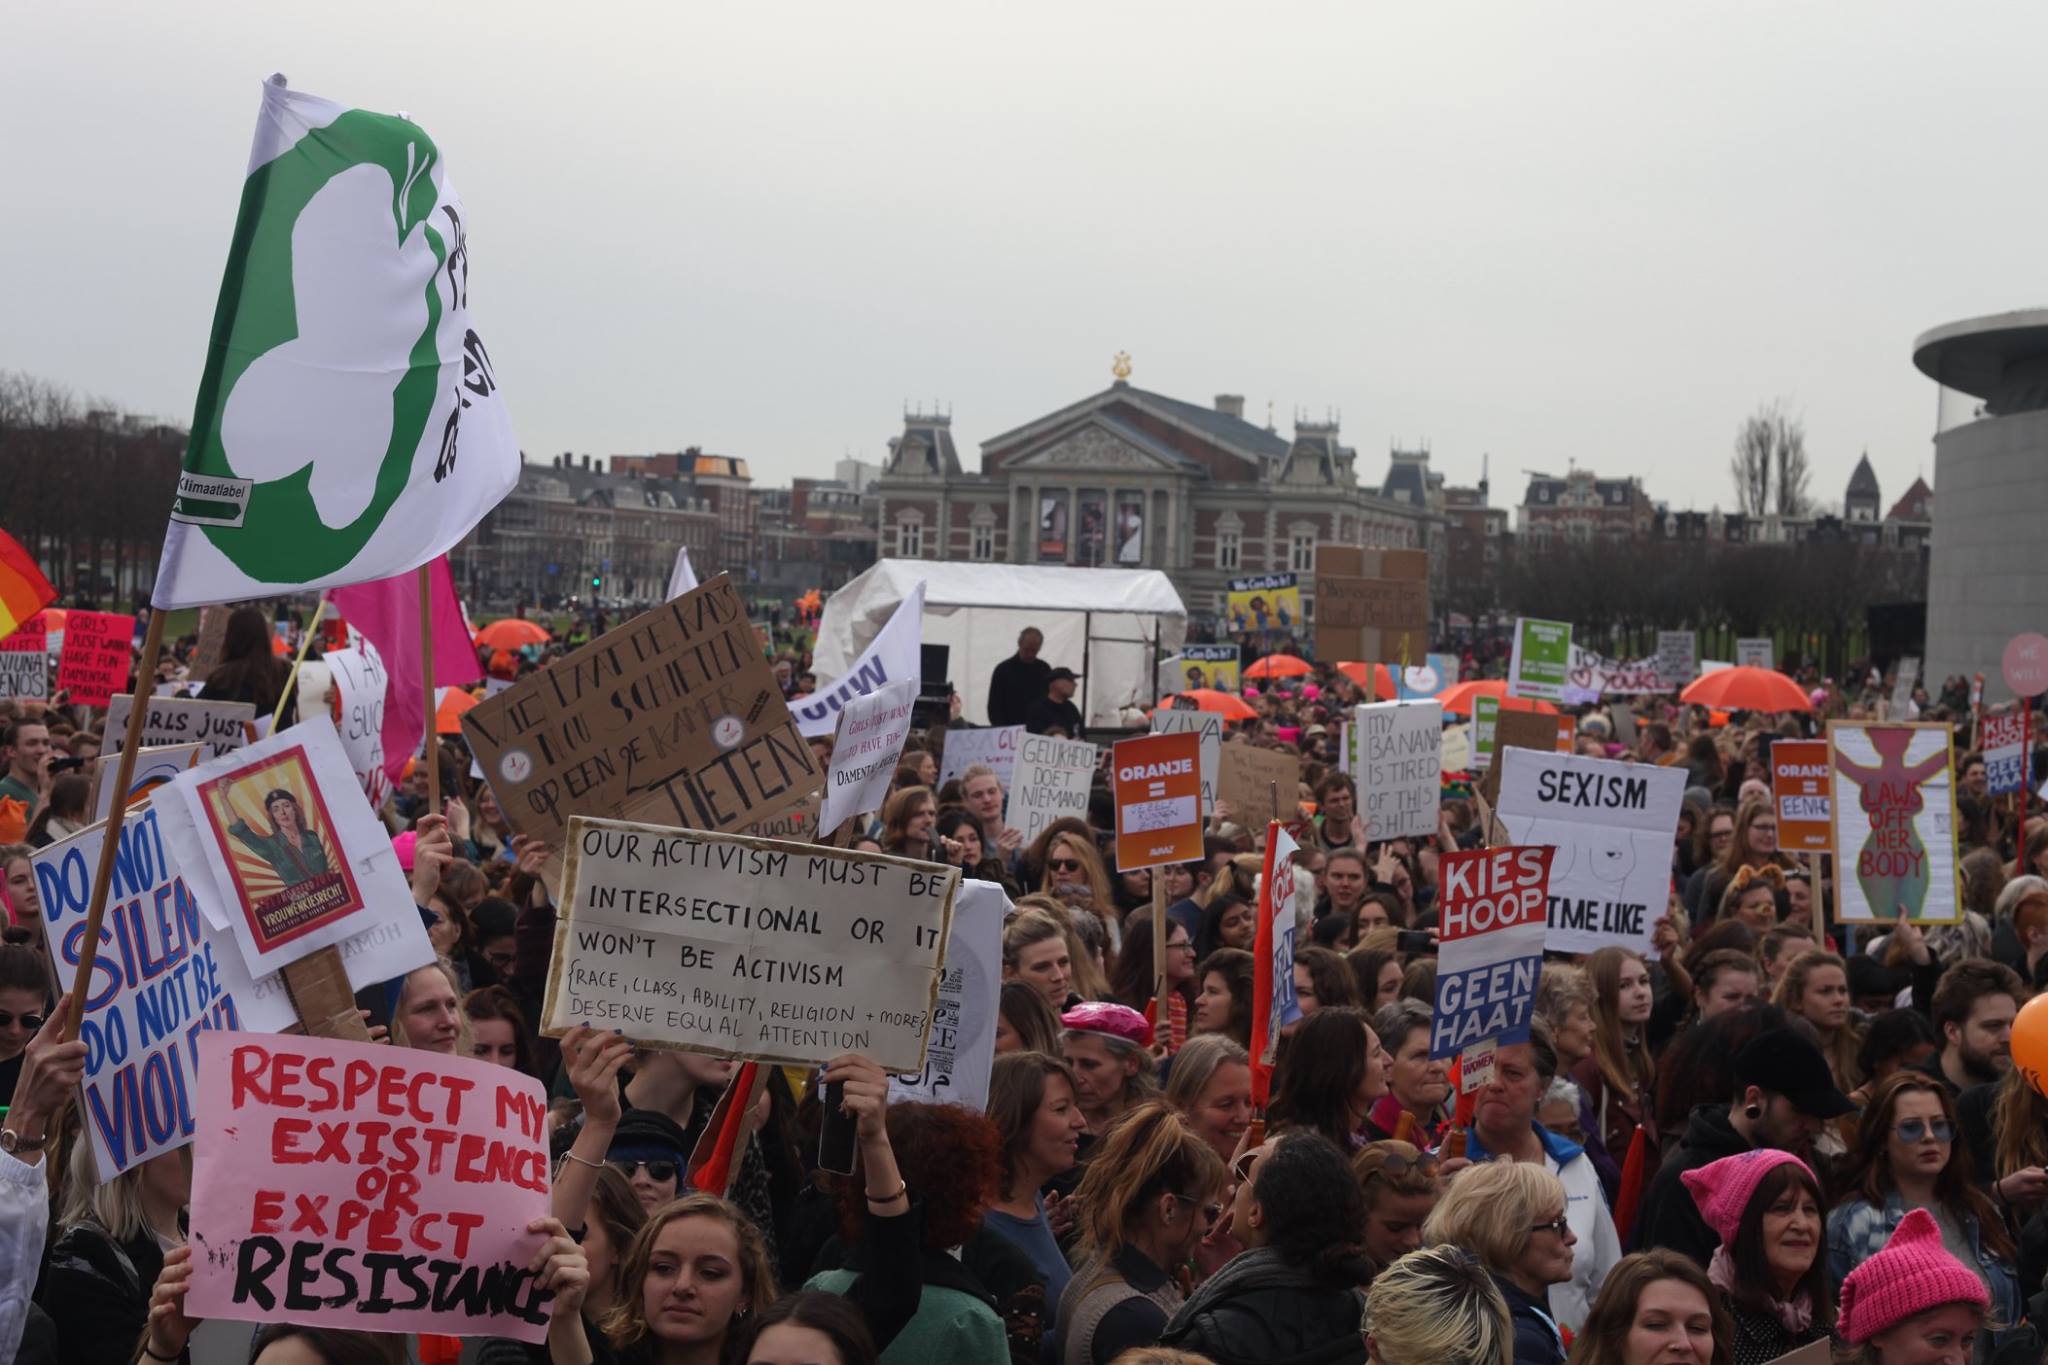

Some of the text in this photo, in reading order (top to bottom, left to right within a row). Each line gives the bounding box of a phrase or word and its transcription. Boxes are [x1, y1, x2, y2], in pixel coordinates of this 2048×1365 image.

[1234, 581, 1248, 591] We
[1248, 579, 1266, 589] Can
[1266, 577, 1279, 588] Do
[69, 614, 109, 633] GIRLS
[1187, 649, 1204, 660] Can
[1204, 649, 1217, 659] Do
[860, 736, 881, 753] HAVE
[1034, 766, 1074, 787] DOET
[1120, 758, 1193, 781] ORANJE
[1368, 756, 1439, 786] IS TIRED
[1537, 769, 1648, 809] SEXISM
[1021, 785, 1087, 810] NIEMAND
[1368, 786, 1433, 812] OF THIS
[1868, 808, 1912, 830] OFF
[1876, 829, 1909, 850] HER
[35, 808, 168, 923] DO NOT
[583, 829, 946, 898] OUR ACTIVISM MUST BE
[1444, 848, 1545, 900] KIES
[1860, 850, 1924, 878] BODY
[589, 885, 940, 951] INTERSECTIONAL OR IT
[1443, 888, 1545, 938] HOOP
[1602, 902, 1648, 935] LIKE
[578, 931, 843, 988] WON'T BE ACTIVISM
[1439, 956, 1535, 1016] GEEN
[81, 1004, 129, 1078] DO
[135, 962, 193, 1050] NOT
[195, 941, 222, 1013] BE
[571, 998, 870, 1049] DESERVE EQUAL ATTENTION
[770, 1002, 855, 1023] RELIGION
[1433, 994, 1532, 1053] HAAT
[231, 1045, 546, 1144] RESPECT MY
[271, 1117, 549, 1194] EXISTENCE
[355, 1166, 422, 1216] OR
[250, 1190, 484, 1260] EXPECT
[231, 1235, 552, 1325] RESISTANCE
